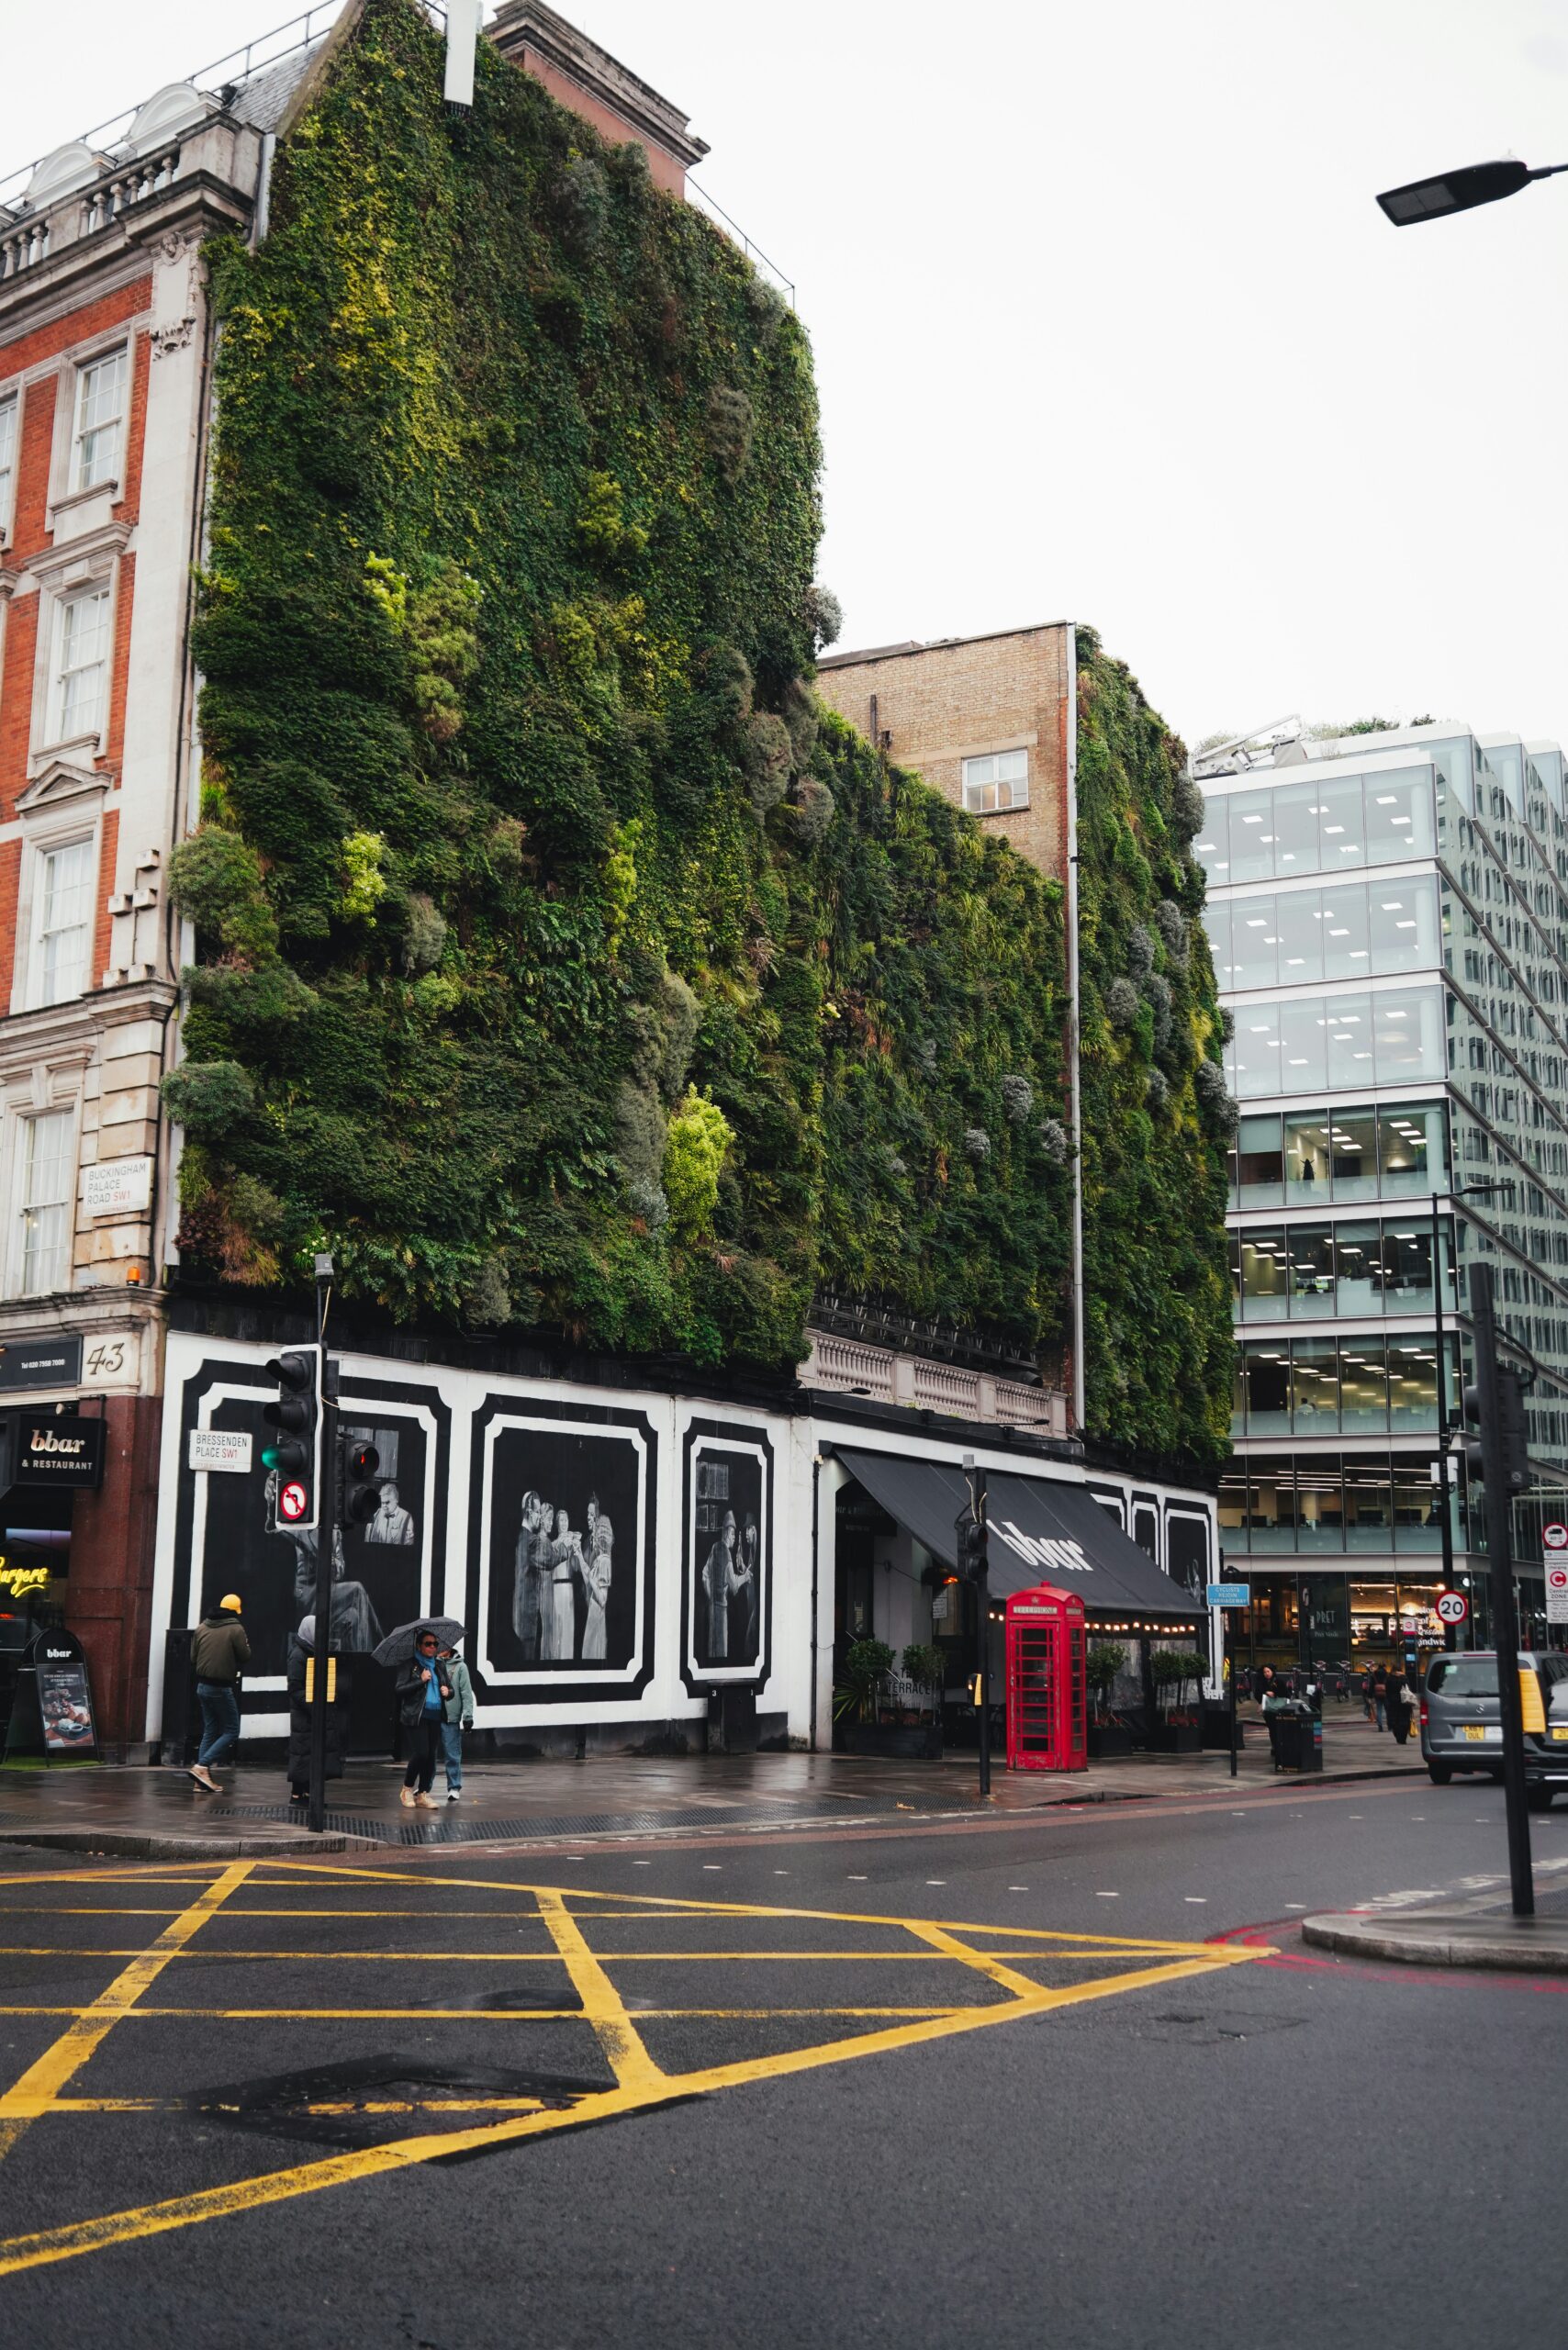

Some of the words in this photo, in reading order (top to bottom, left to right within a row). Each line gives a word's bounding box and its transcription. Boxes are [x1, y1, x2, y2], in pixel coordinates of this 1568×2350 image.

[89, 1163, 146, 1181] BUCKINGHAM
[88, 1179, 121, 1192] PALACE
[87, 1193, 111, 1205] ROAD
[113, 1190, 130, 1202] SW1
[86, 1342, 125, 1375] 43
[30, 1429, 85, 1453] bbar
[196, 1435, 247, 1448] BRESSENDEN
[196, 1447, 219, 1458] PLACE
[221, 1449, 237, 1459] SW1
[22, 1459, 28, 1468] &
[33, 1460, 93, 1470] RESTAURANT
[986, 1519, 1093, 1571] bbar
[1440, 1601, 1463, 1615] 20
[1316, 1611, 1337, 1624] PRET
[47, 1649, 72, 1658] bbar
[888, 1682, 932, 1695] TERRACE
